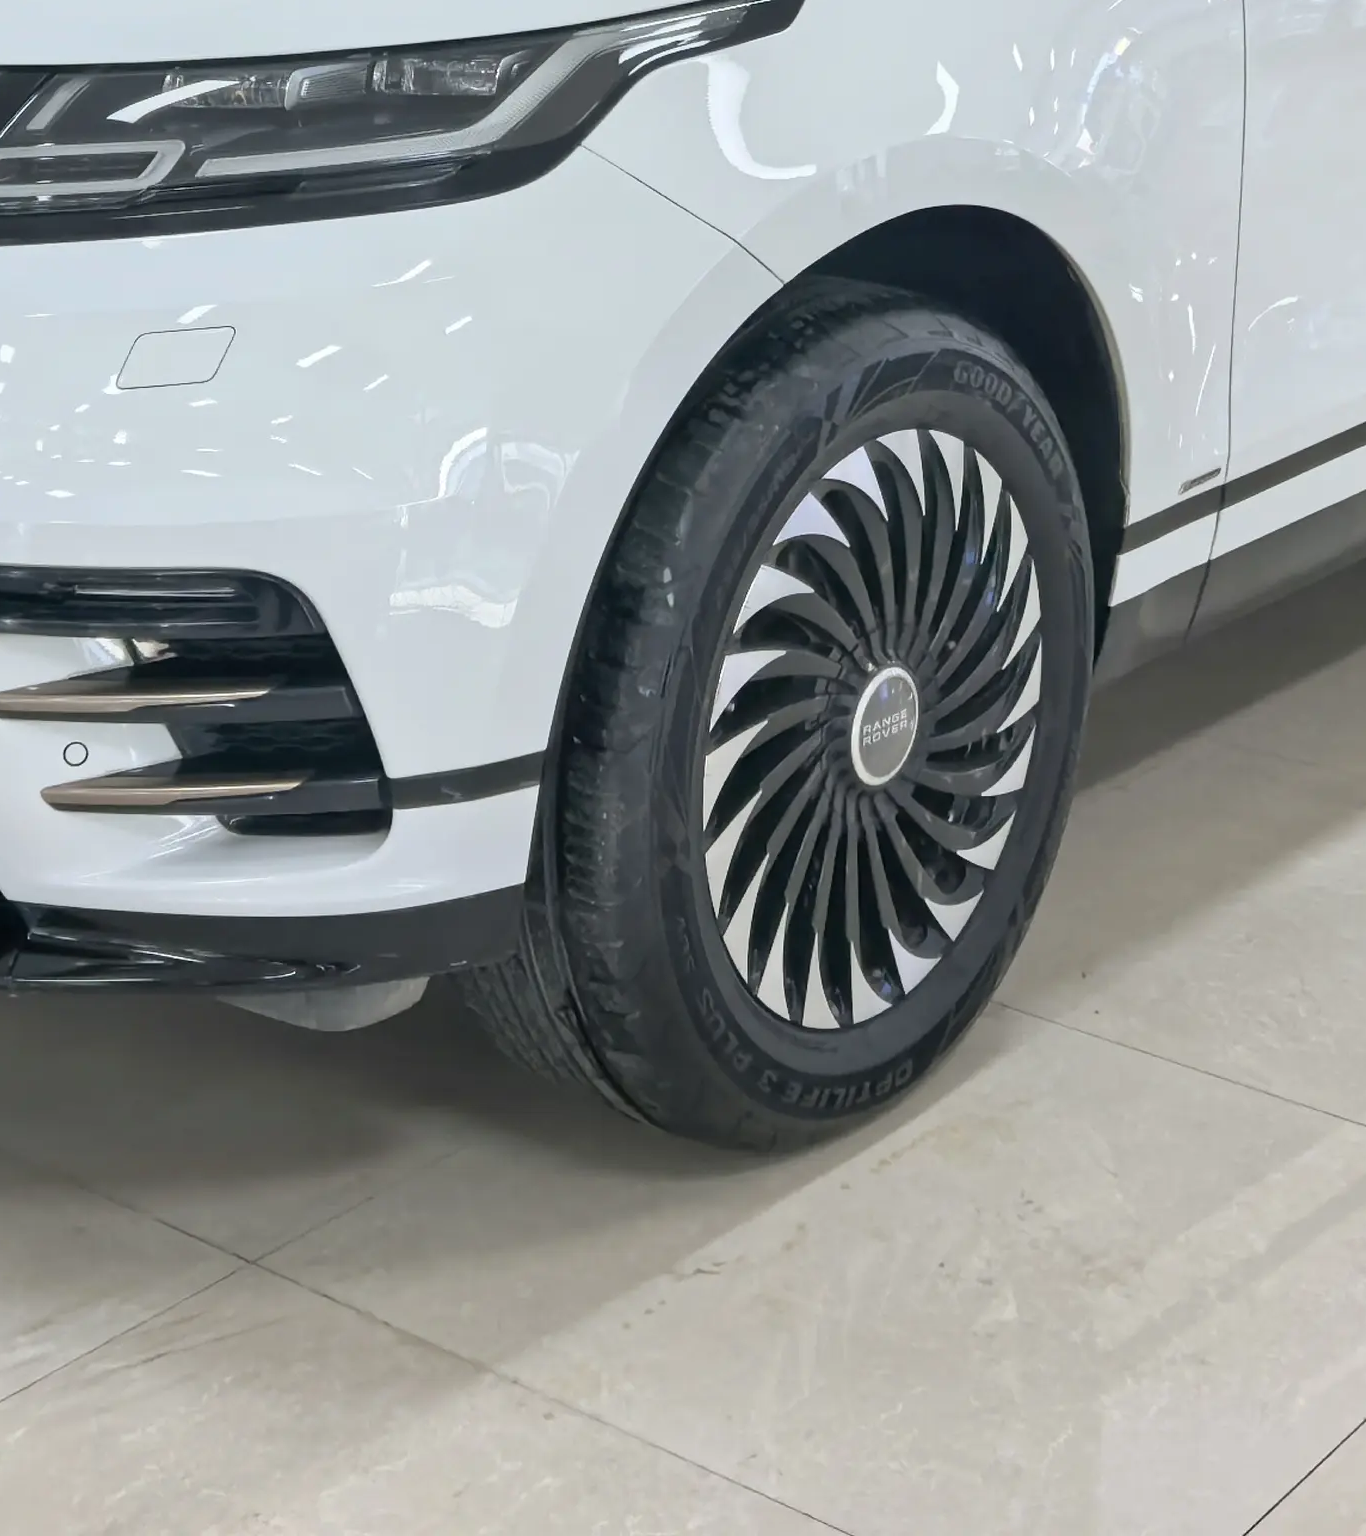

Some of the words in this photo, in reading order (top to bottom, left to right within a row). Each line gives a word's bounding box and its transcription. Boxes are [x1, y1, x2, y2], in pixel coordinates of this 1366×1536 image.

[863, 708, 907, 736] RANGE
[863, 720, 907, 746] ROVER
[784, 1059, 913, 1109] OPTILIFE
